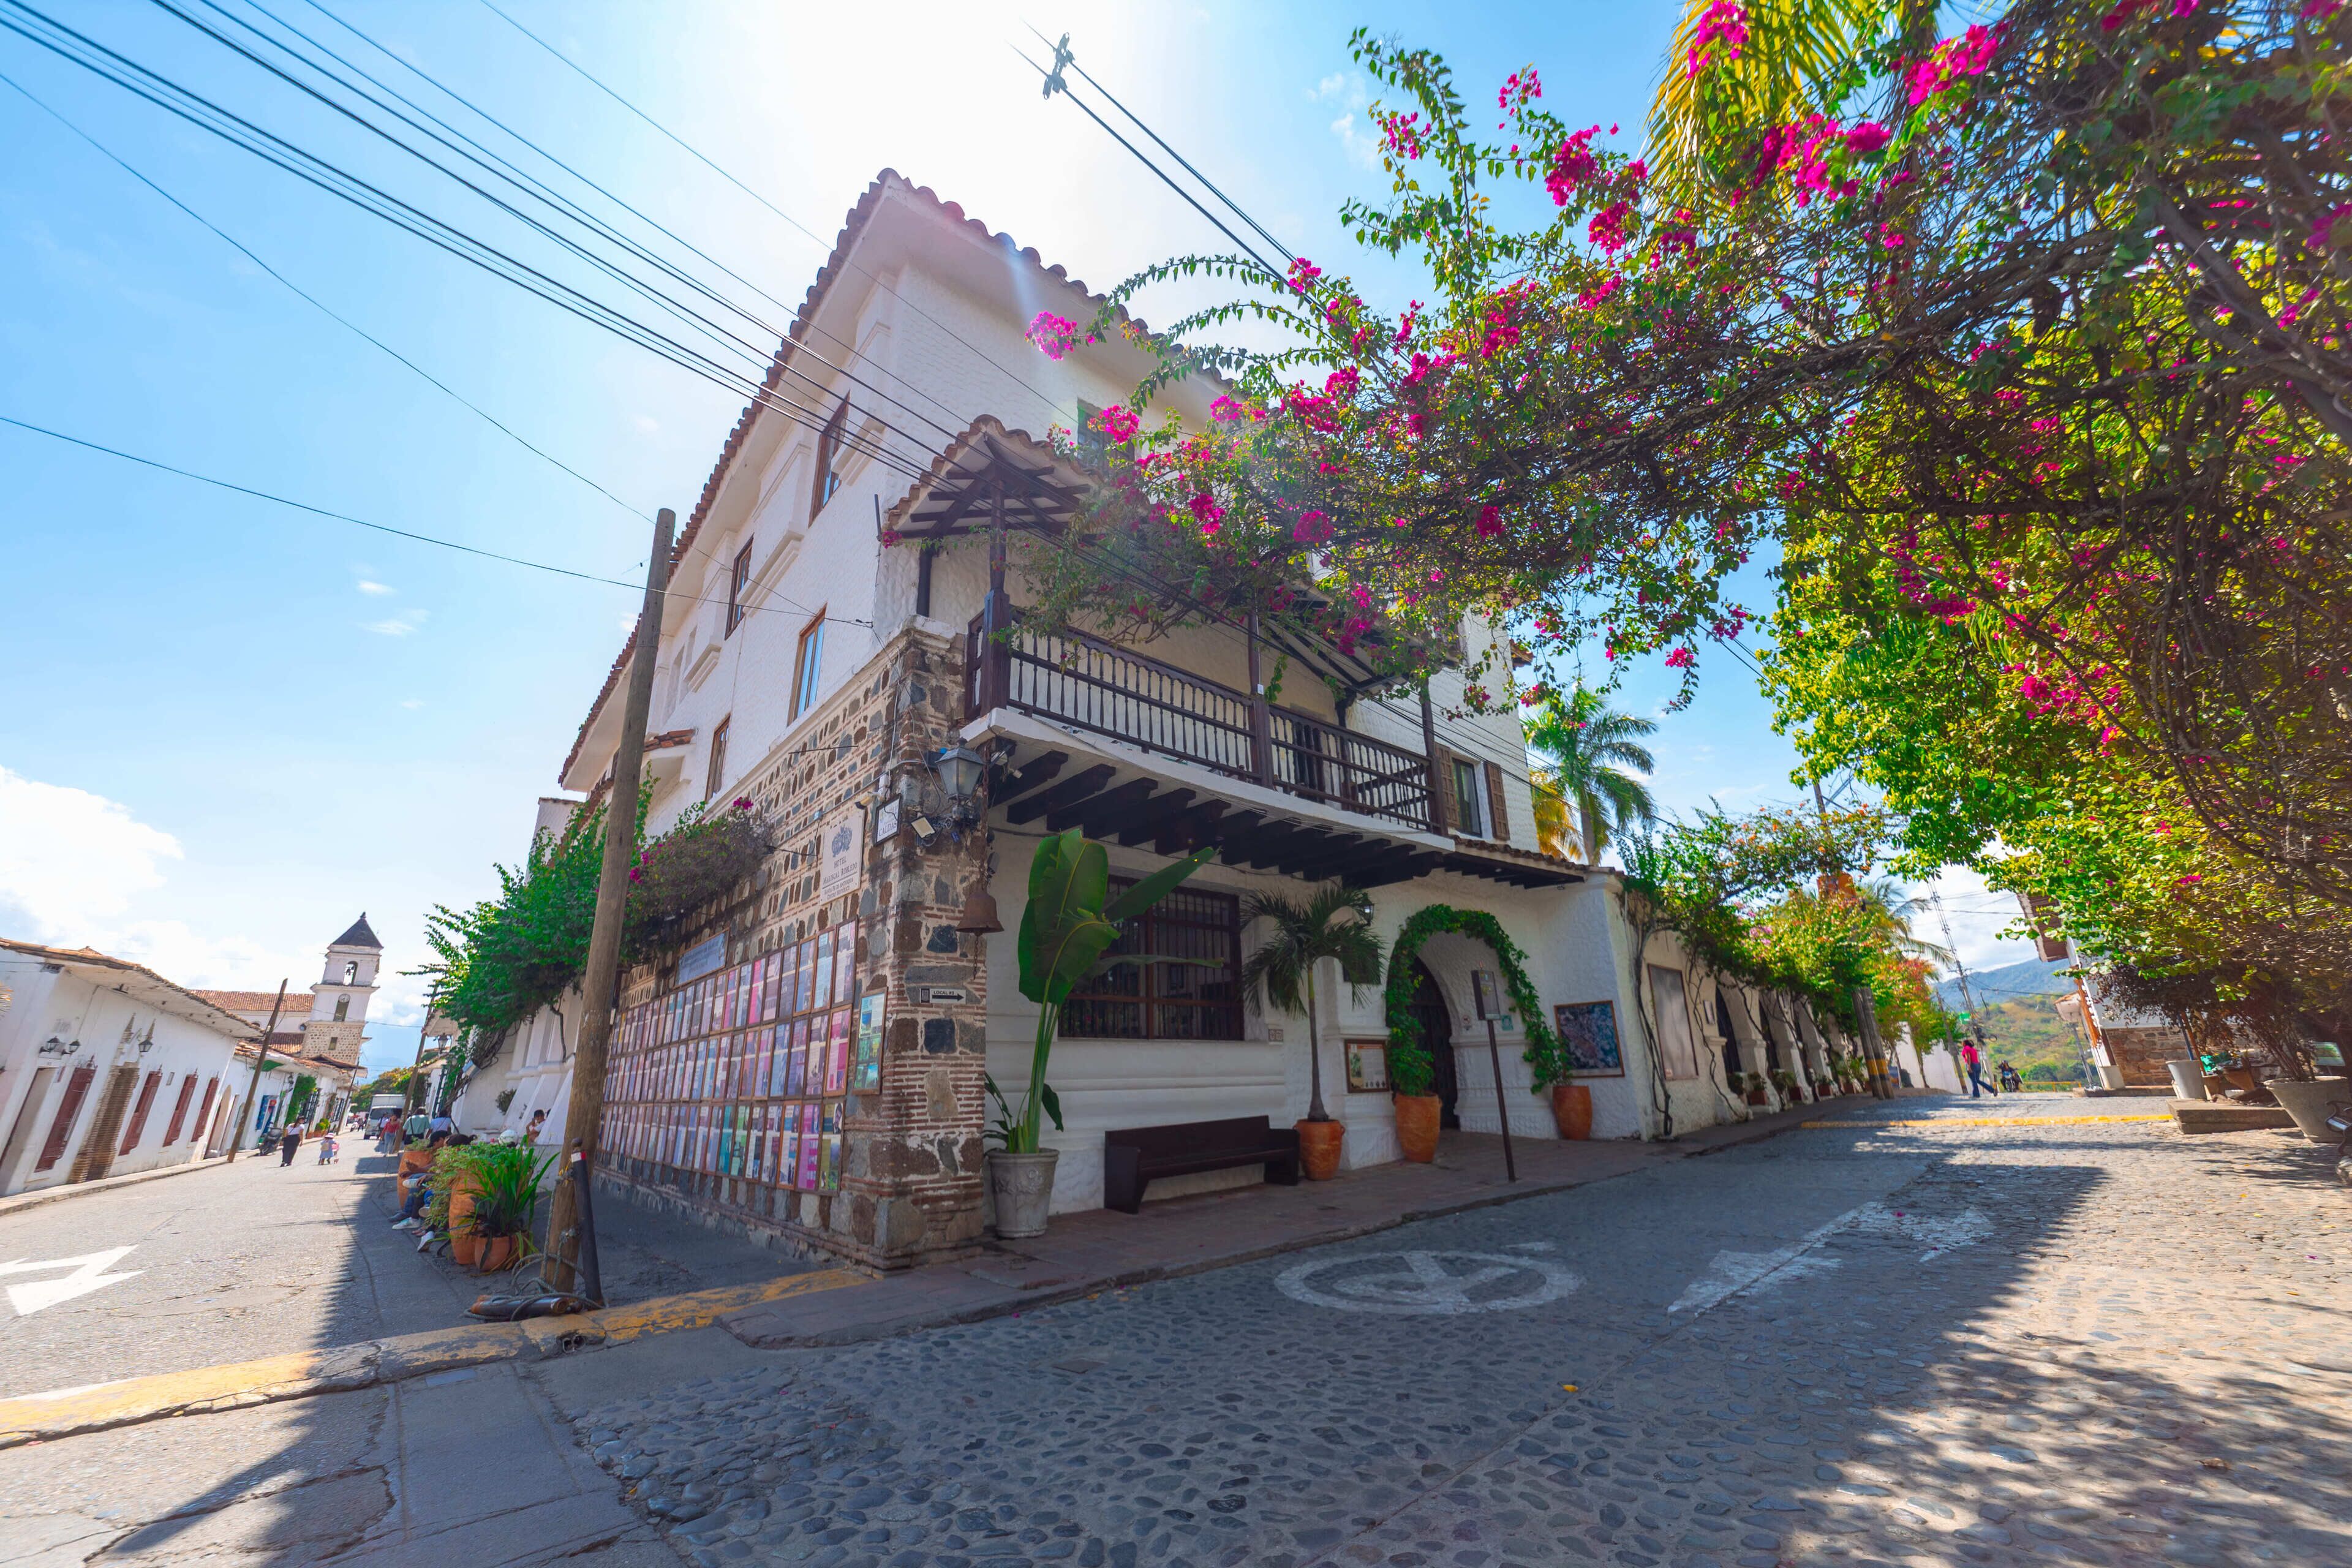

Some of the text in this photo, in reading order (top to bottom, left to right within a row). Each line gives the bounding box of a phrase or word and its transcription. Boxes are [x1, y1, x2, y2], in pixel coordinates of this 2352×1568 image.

[878, 822, 897, 837] CALDAS
[834, 856, 846, 869] HOTEL
[823, 862, 858, 885] MARISCAL ROBLEDO
